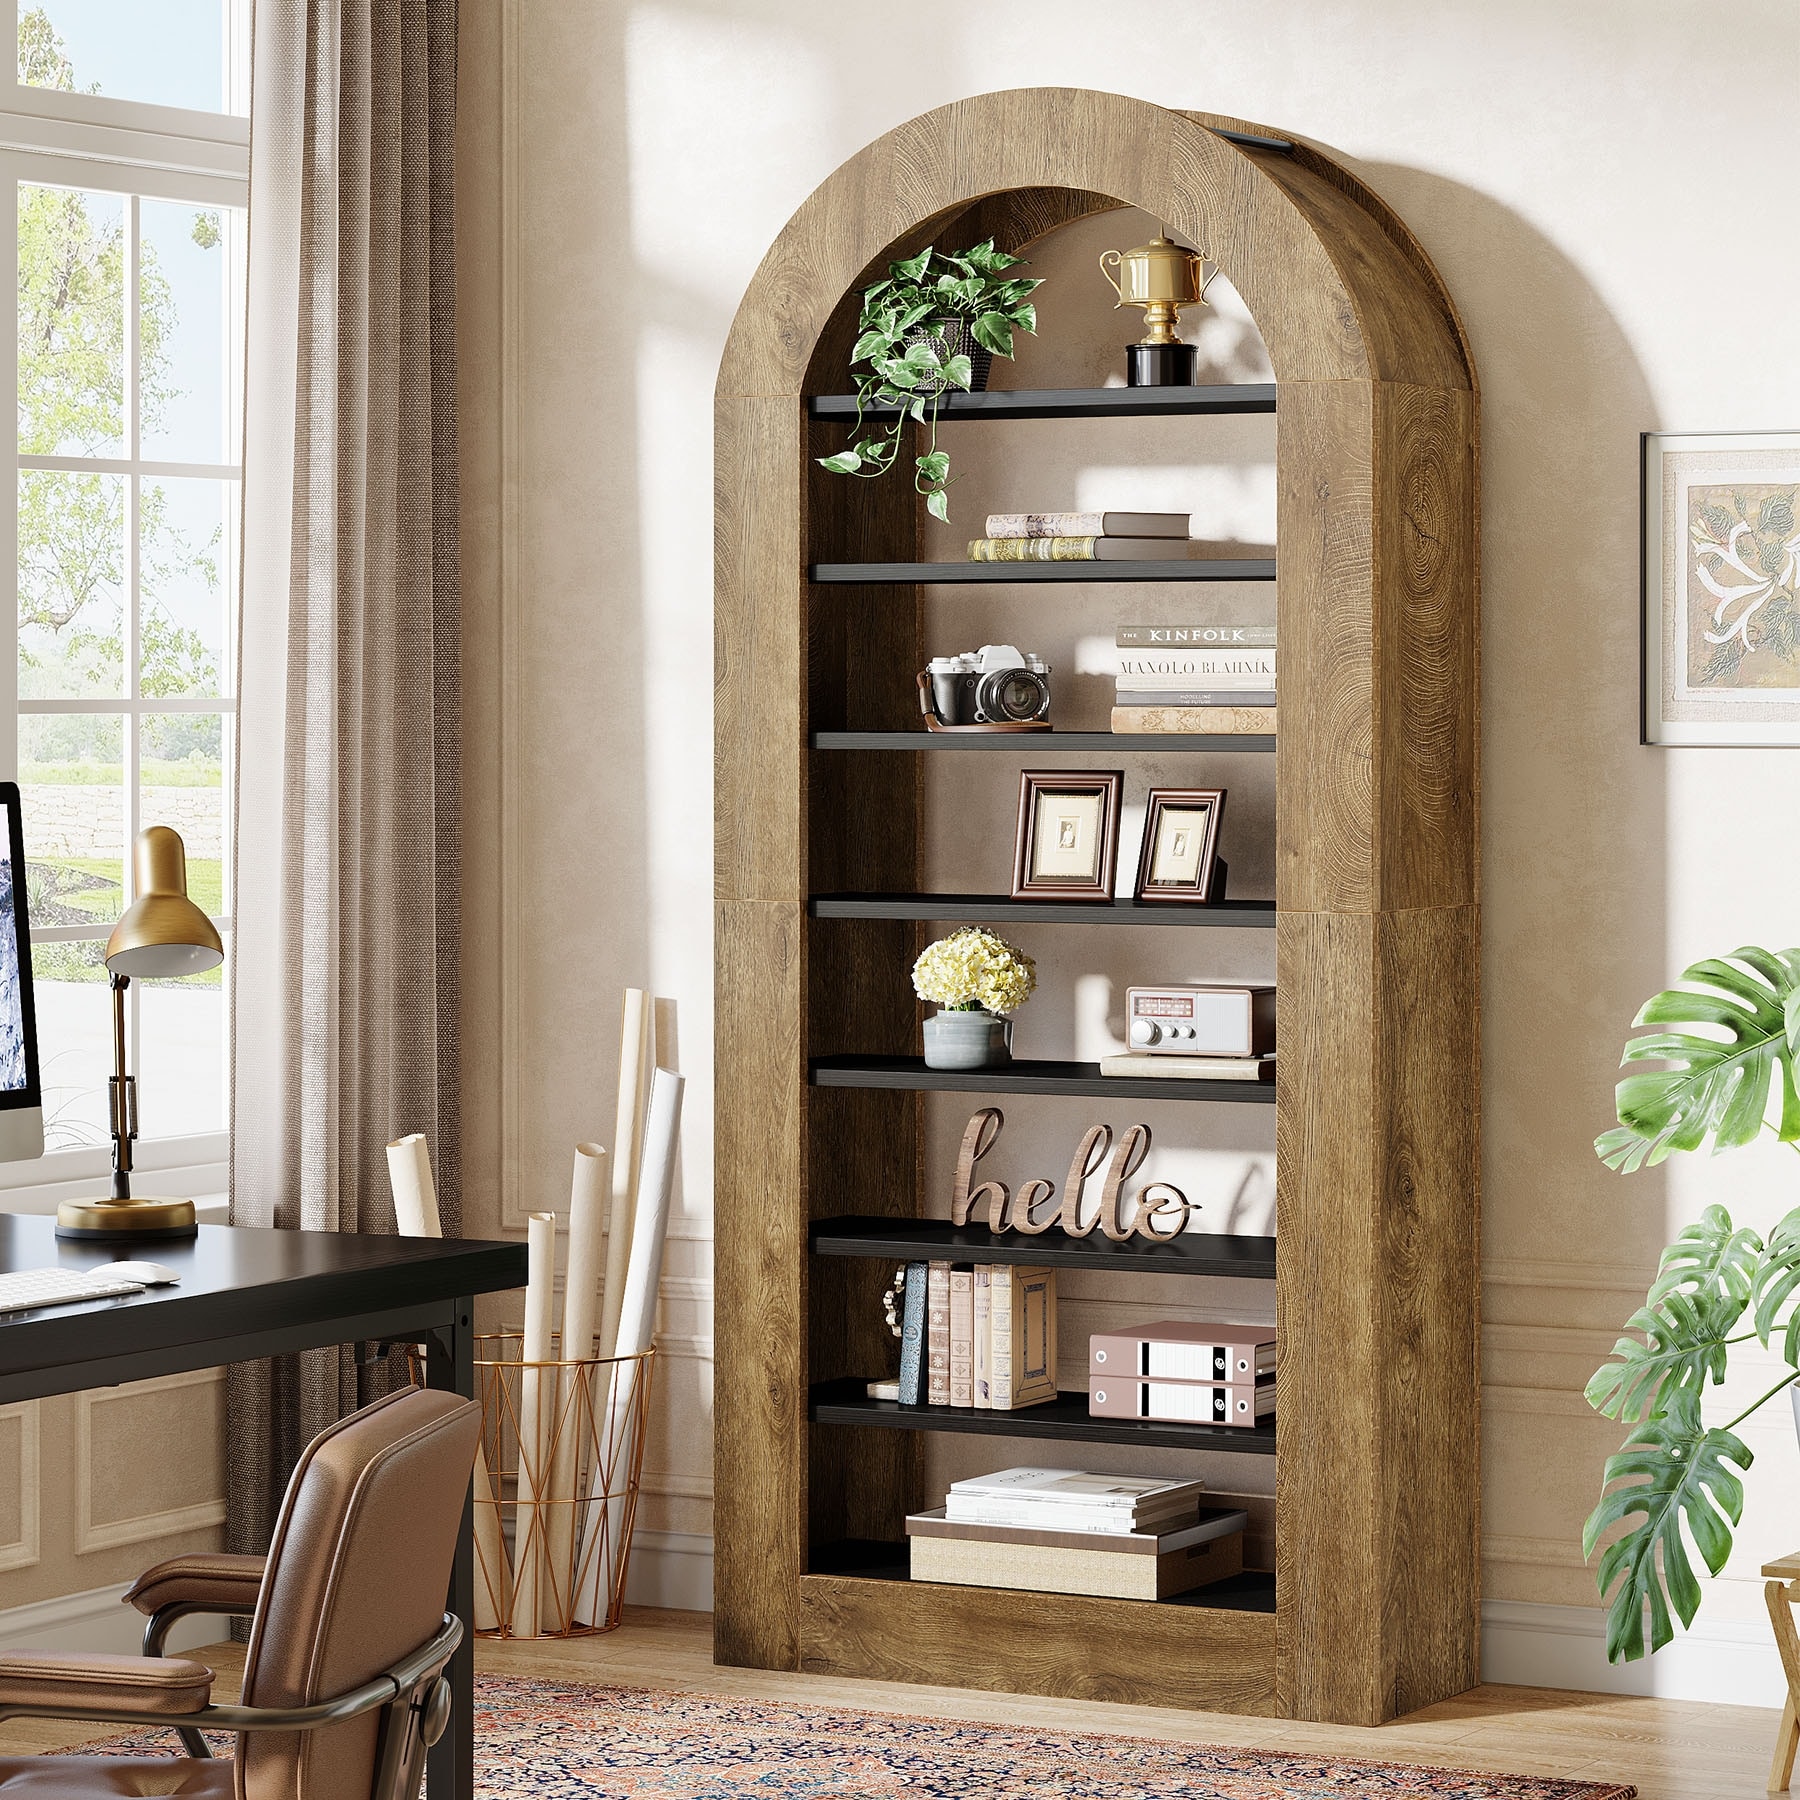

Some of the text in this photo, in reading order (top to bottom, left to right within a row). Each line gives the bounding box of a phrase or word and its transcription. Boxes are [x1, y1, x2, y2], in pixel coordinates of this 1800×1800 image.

[1150, 629, 1245, 641] KINFOLK
[1121, 658, 1270, 674] MANOLO BLAHNÍK
[951, 1107, 1203, 1242] hello
